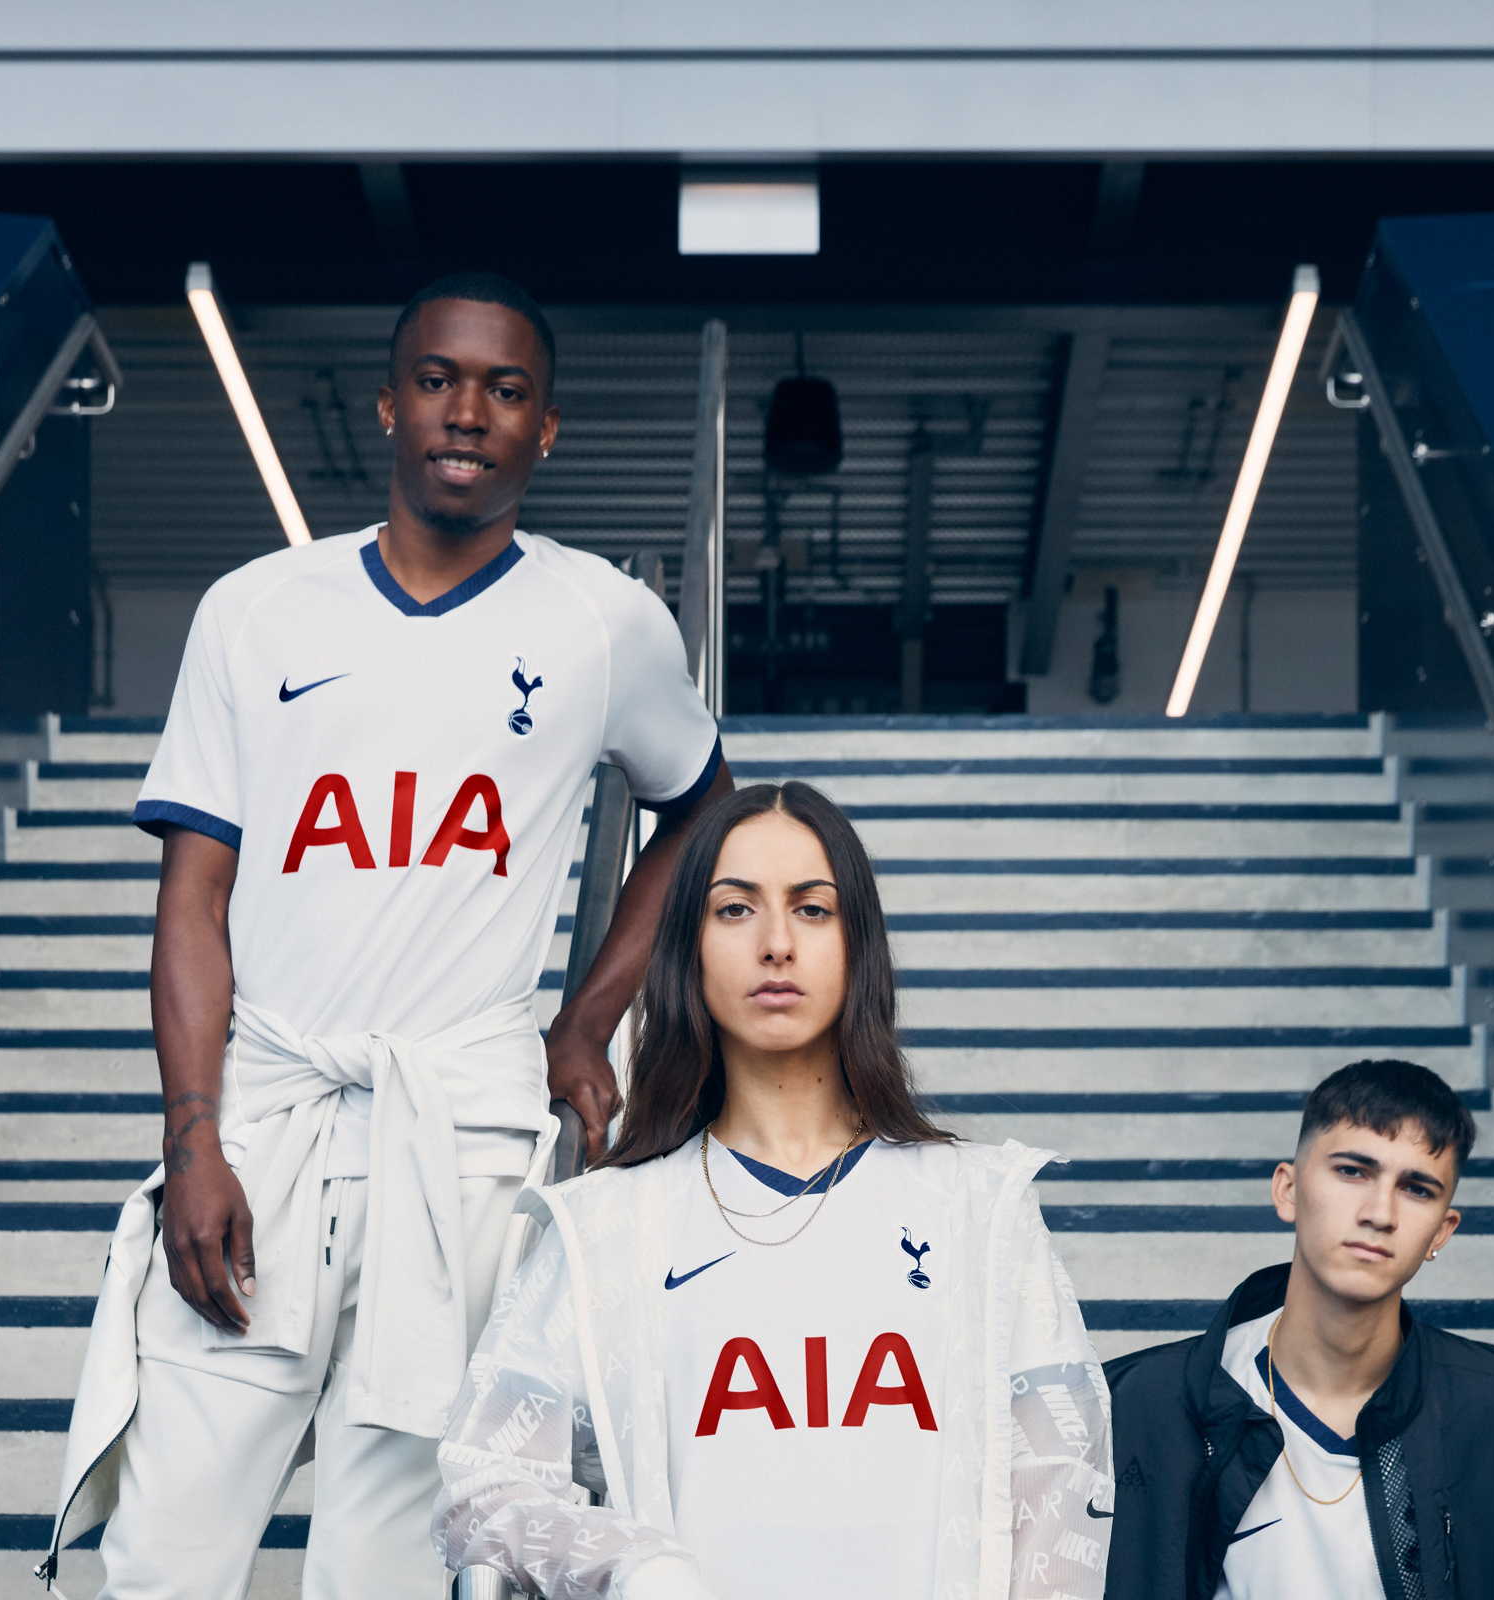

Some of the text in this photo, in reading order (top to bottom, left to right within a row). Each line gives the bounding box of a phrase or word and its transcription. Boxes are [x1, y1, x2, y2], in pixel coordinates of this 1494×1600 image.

[281, 771, 511, 877] AIA
[695, 1332, 938, 1437] AIA
[1036, 1384, 1089, 1439] NIKE
[486, 1398, 541, 1457] NIKE
[523, 1518, 554, 1584] AIR
[1052, 1527, 1102, 1568] NIKE
